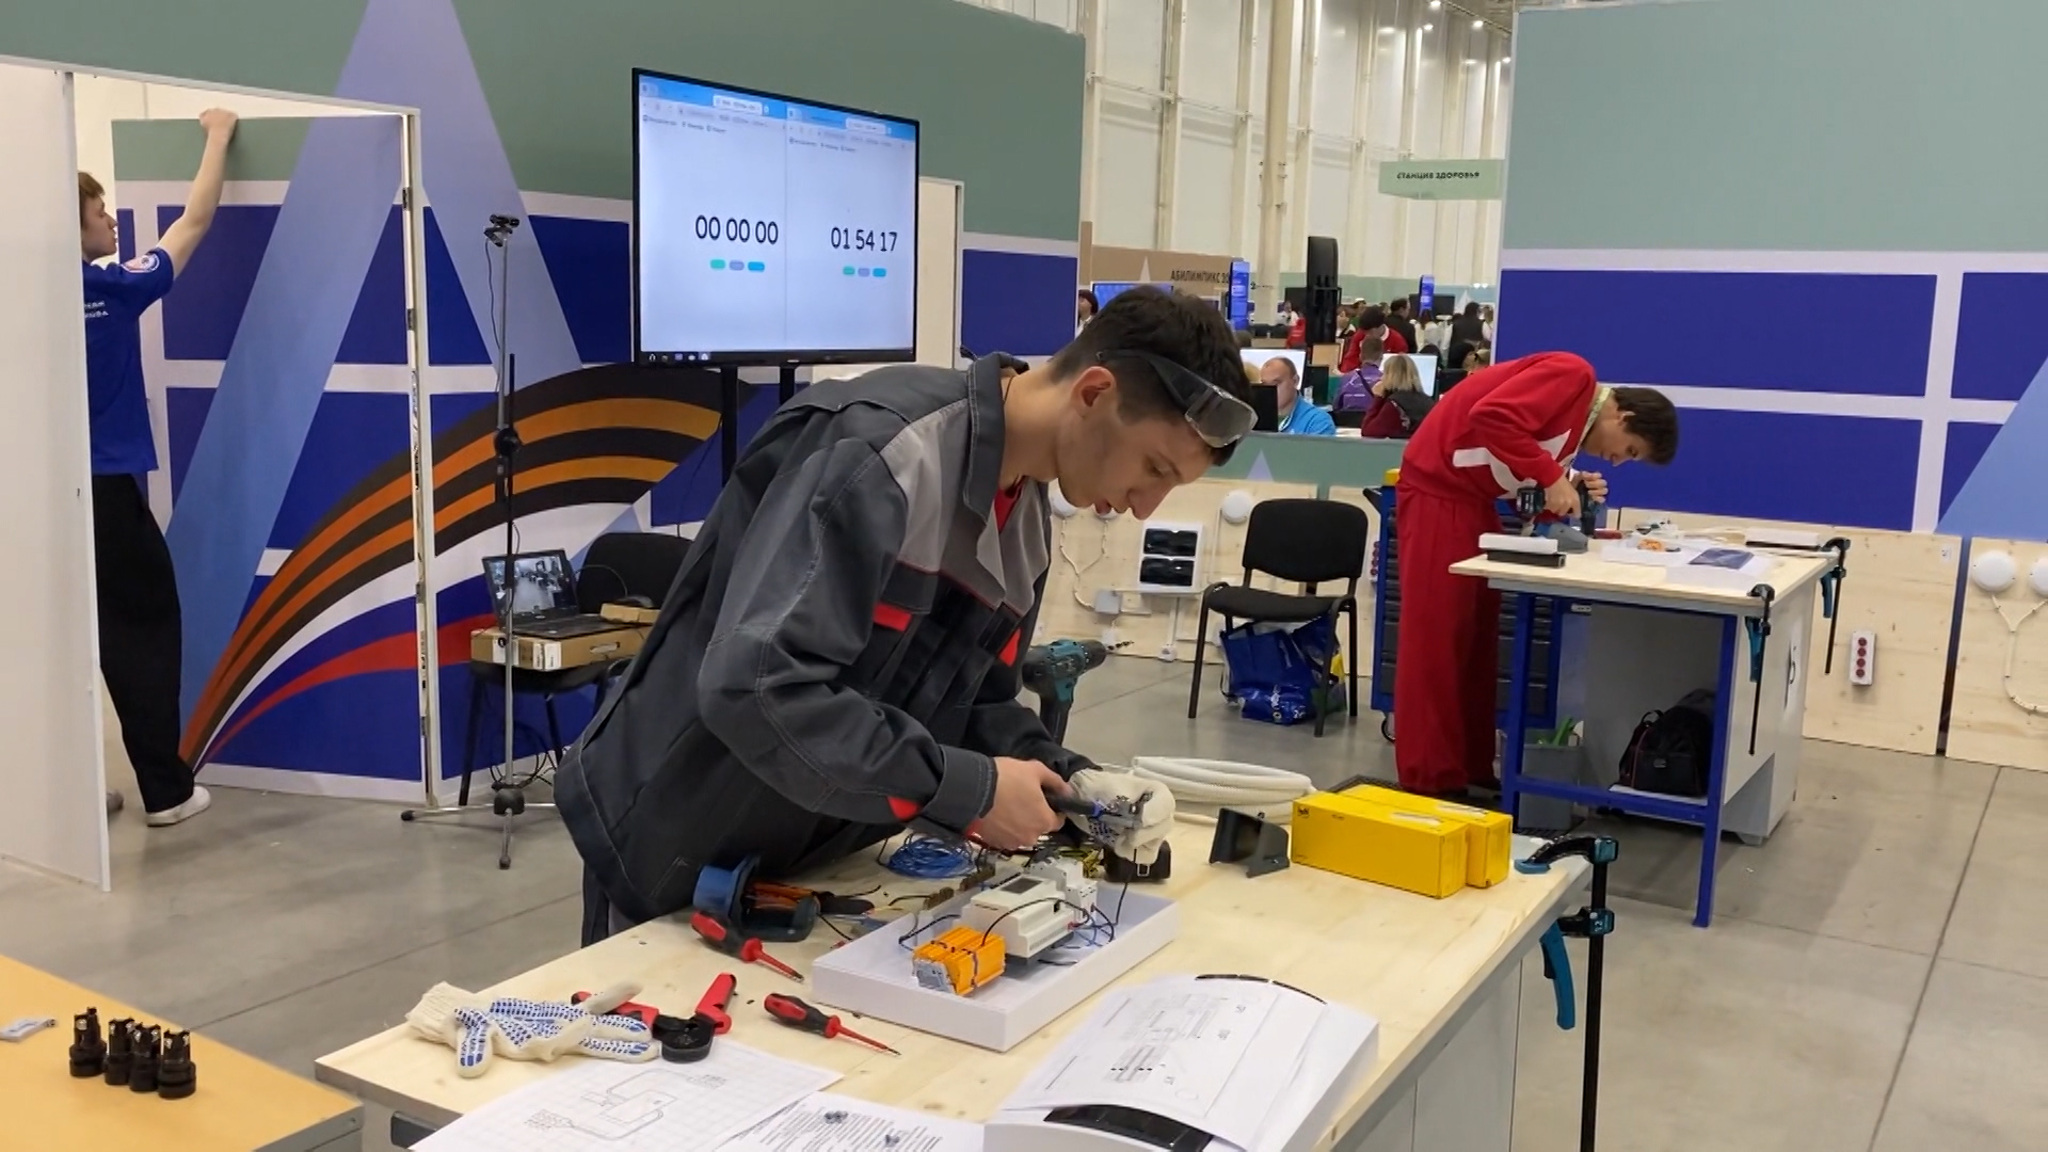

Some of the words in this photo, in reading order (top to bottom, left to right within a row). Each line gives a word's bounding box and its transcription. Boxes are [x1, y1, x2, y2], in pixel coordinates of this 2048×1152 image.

[695, 214, 721, 241] 00
[726, 217, 750, 243] 00
[755, 220, 779, 245] 00
[830, 226, 851, 250] 01
[855, 229, 875, 251] 54
[880, 231, 898, 252] 17
[1170, 270, 1221, 283] АБИЛИМПИКС
